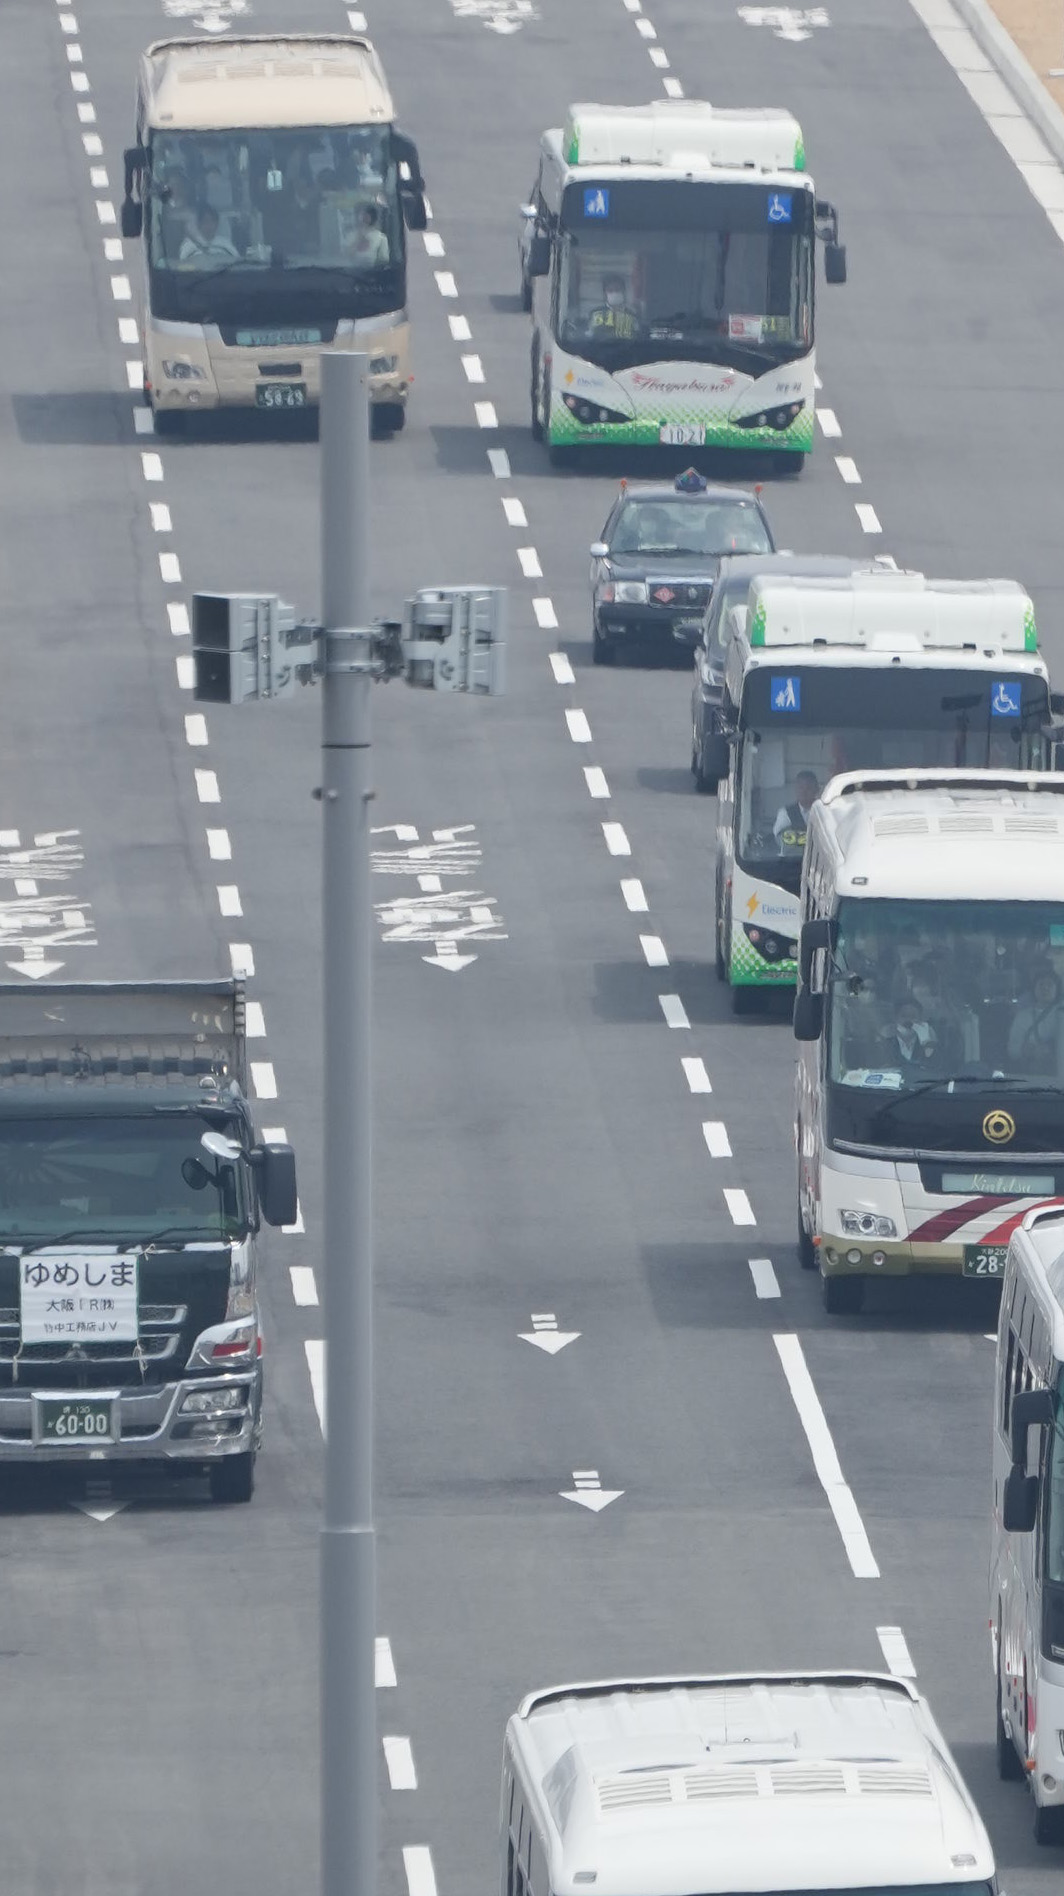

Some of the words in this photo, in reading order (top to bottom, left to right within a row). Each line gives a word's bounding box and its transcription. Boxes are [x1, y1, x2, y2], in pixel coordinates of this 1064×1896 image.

[24, 1261, 134, 1287] ゆめしま
[55, 1413, 107, 1436] 60-00
